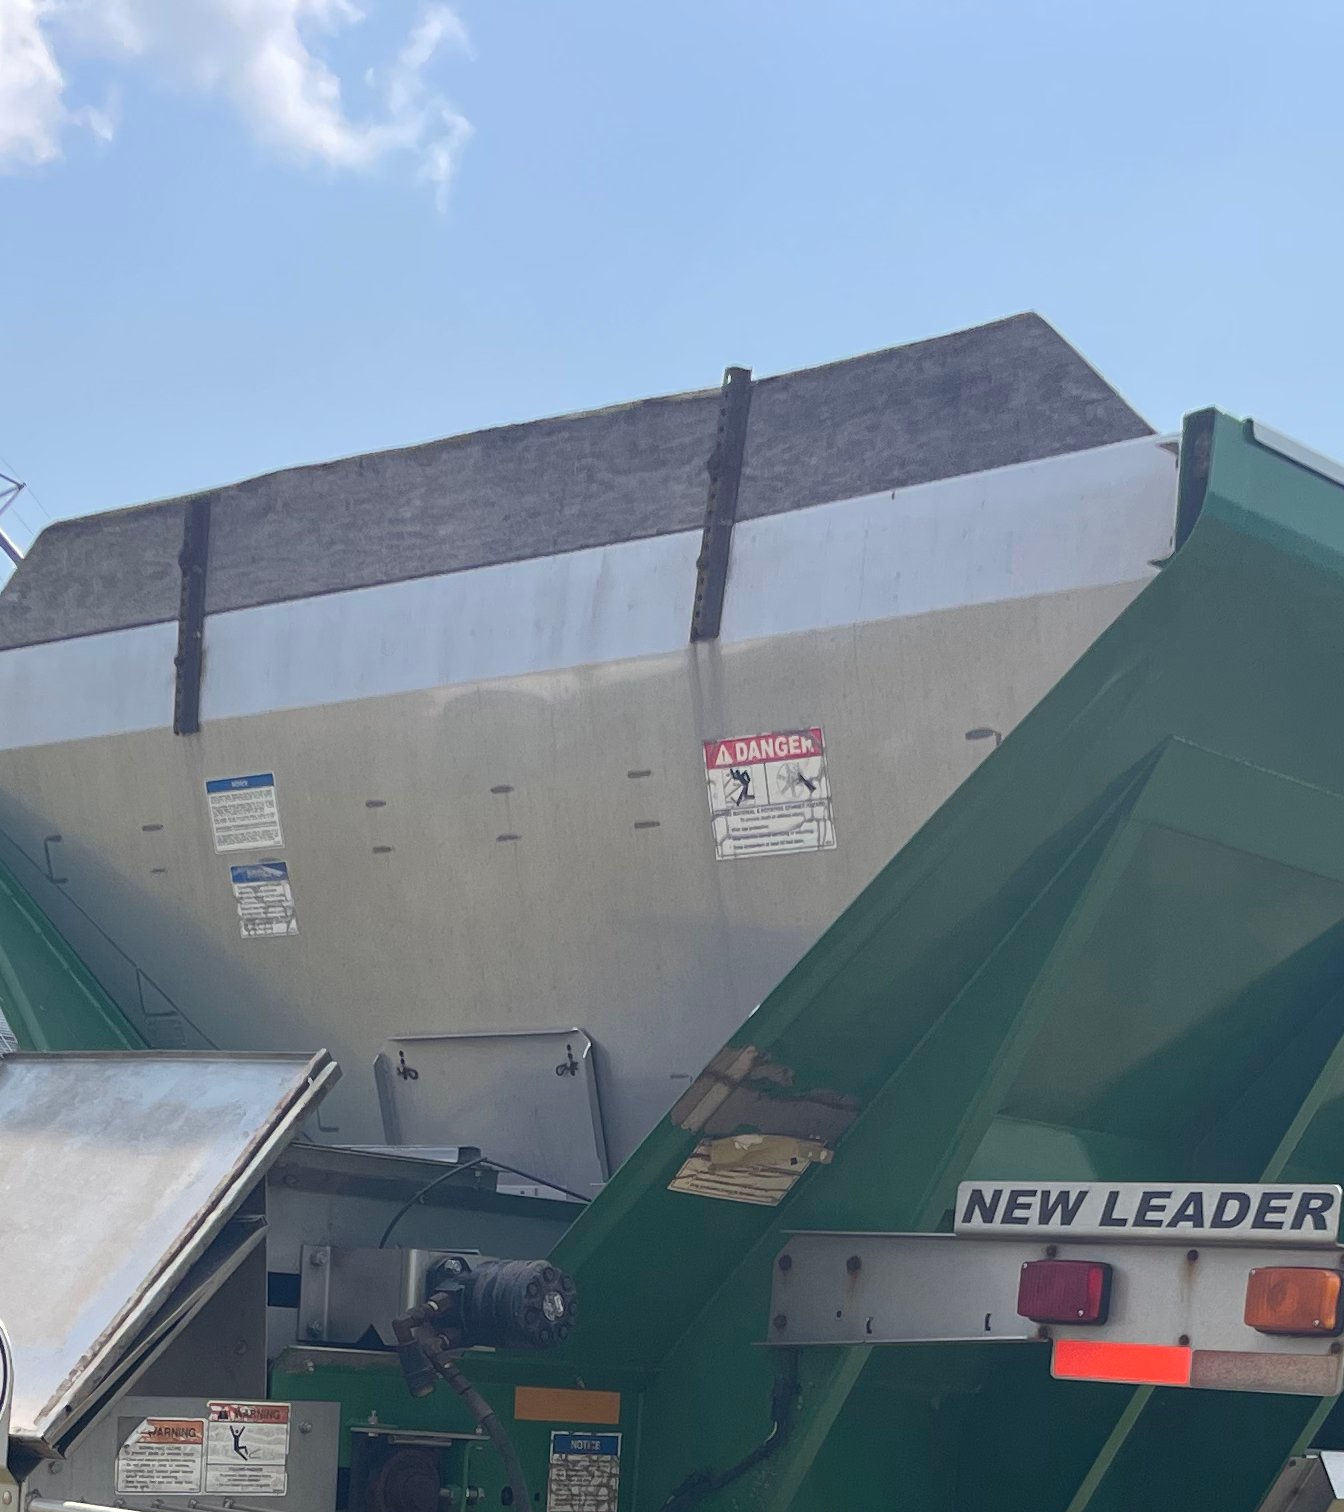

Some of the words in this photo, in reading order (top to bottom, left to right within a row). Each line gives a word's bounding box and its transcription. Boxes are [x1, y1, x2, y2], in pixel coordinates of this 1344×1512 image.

[734, 735, 815, 762] DANGER
[961, 1189, 1090, 1226] NEW
[1099, 1190, 1335, 1231] LEADER
[235, 1408, 281, 1420] WARNING
[570, 1439, 601, 1450] NOTICE
